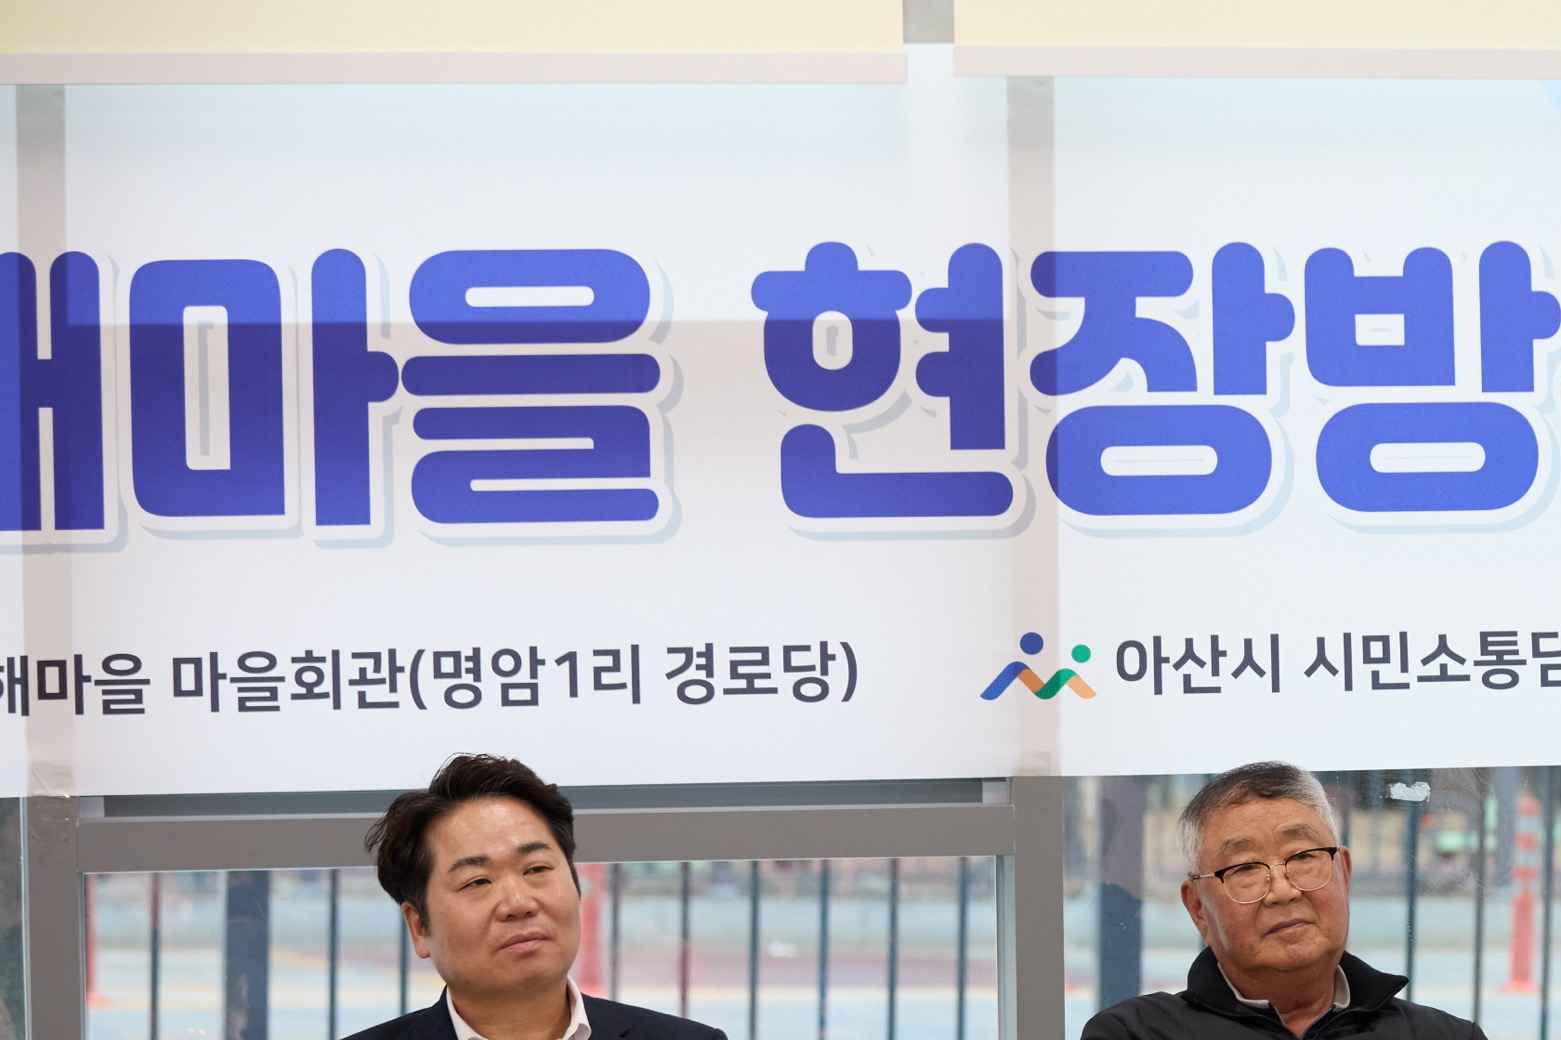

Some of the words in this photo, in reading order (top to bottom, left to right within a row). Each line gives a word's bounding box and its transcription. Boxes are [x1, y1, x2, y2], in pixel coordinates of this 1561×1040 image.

[172, 644, 642, 713] 마을회관(명암1리
[665, 640, 859, 705] 경로당)
[1116, 633, 1281, 696] 아산시
